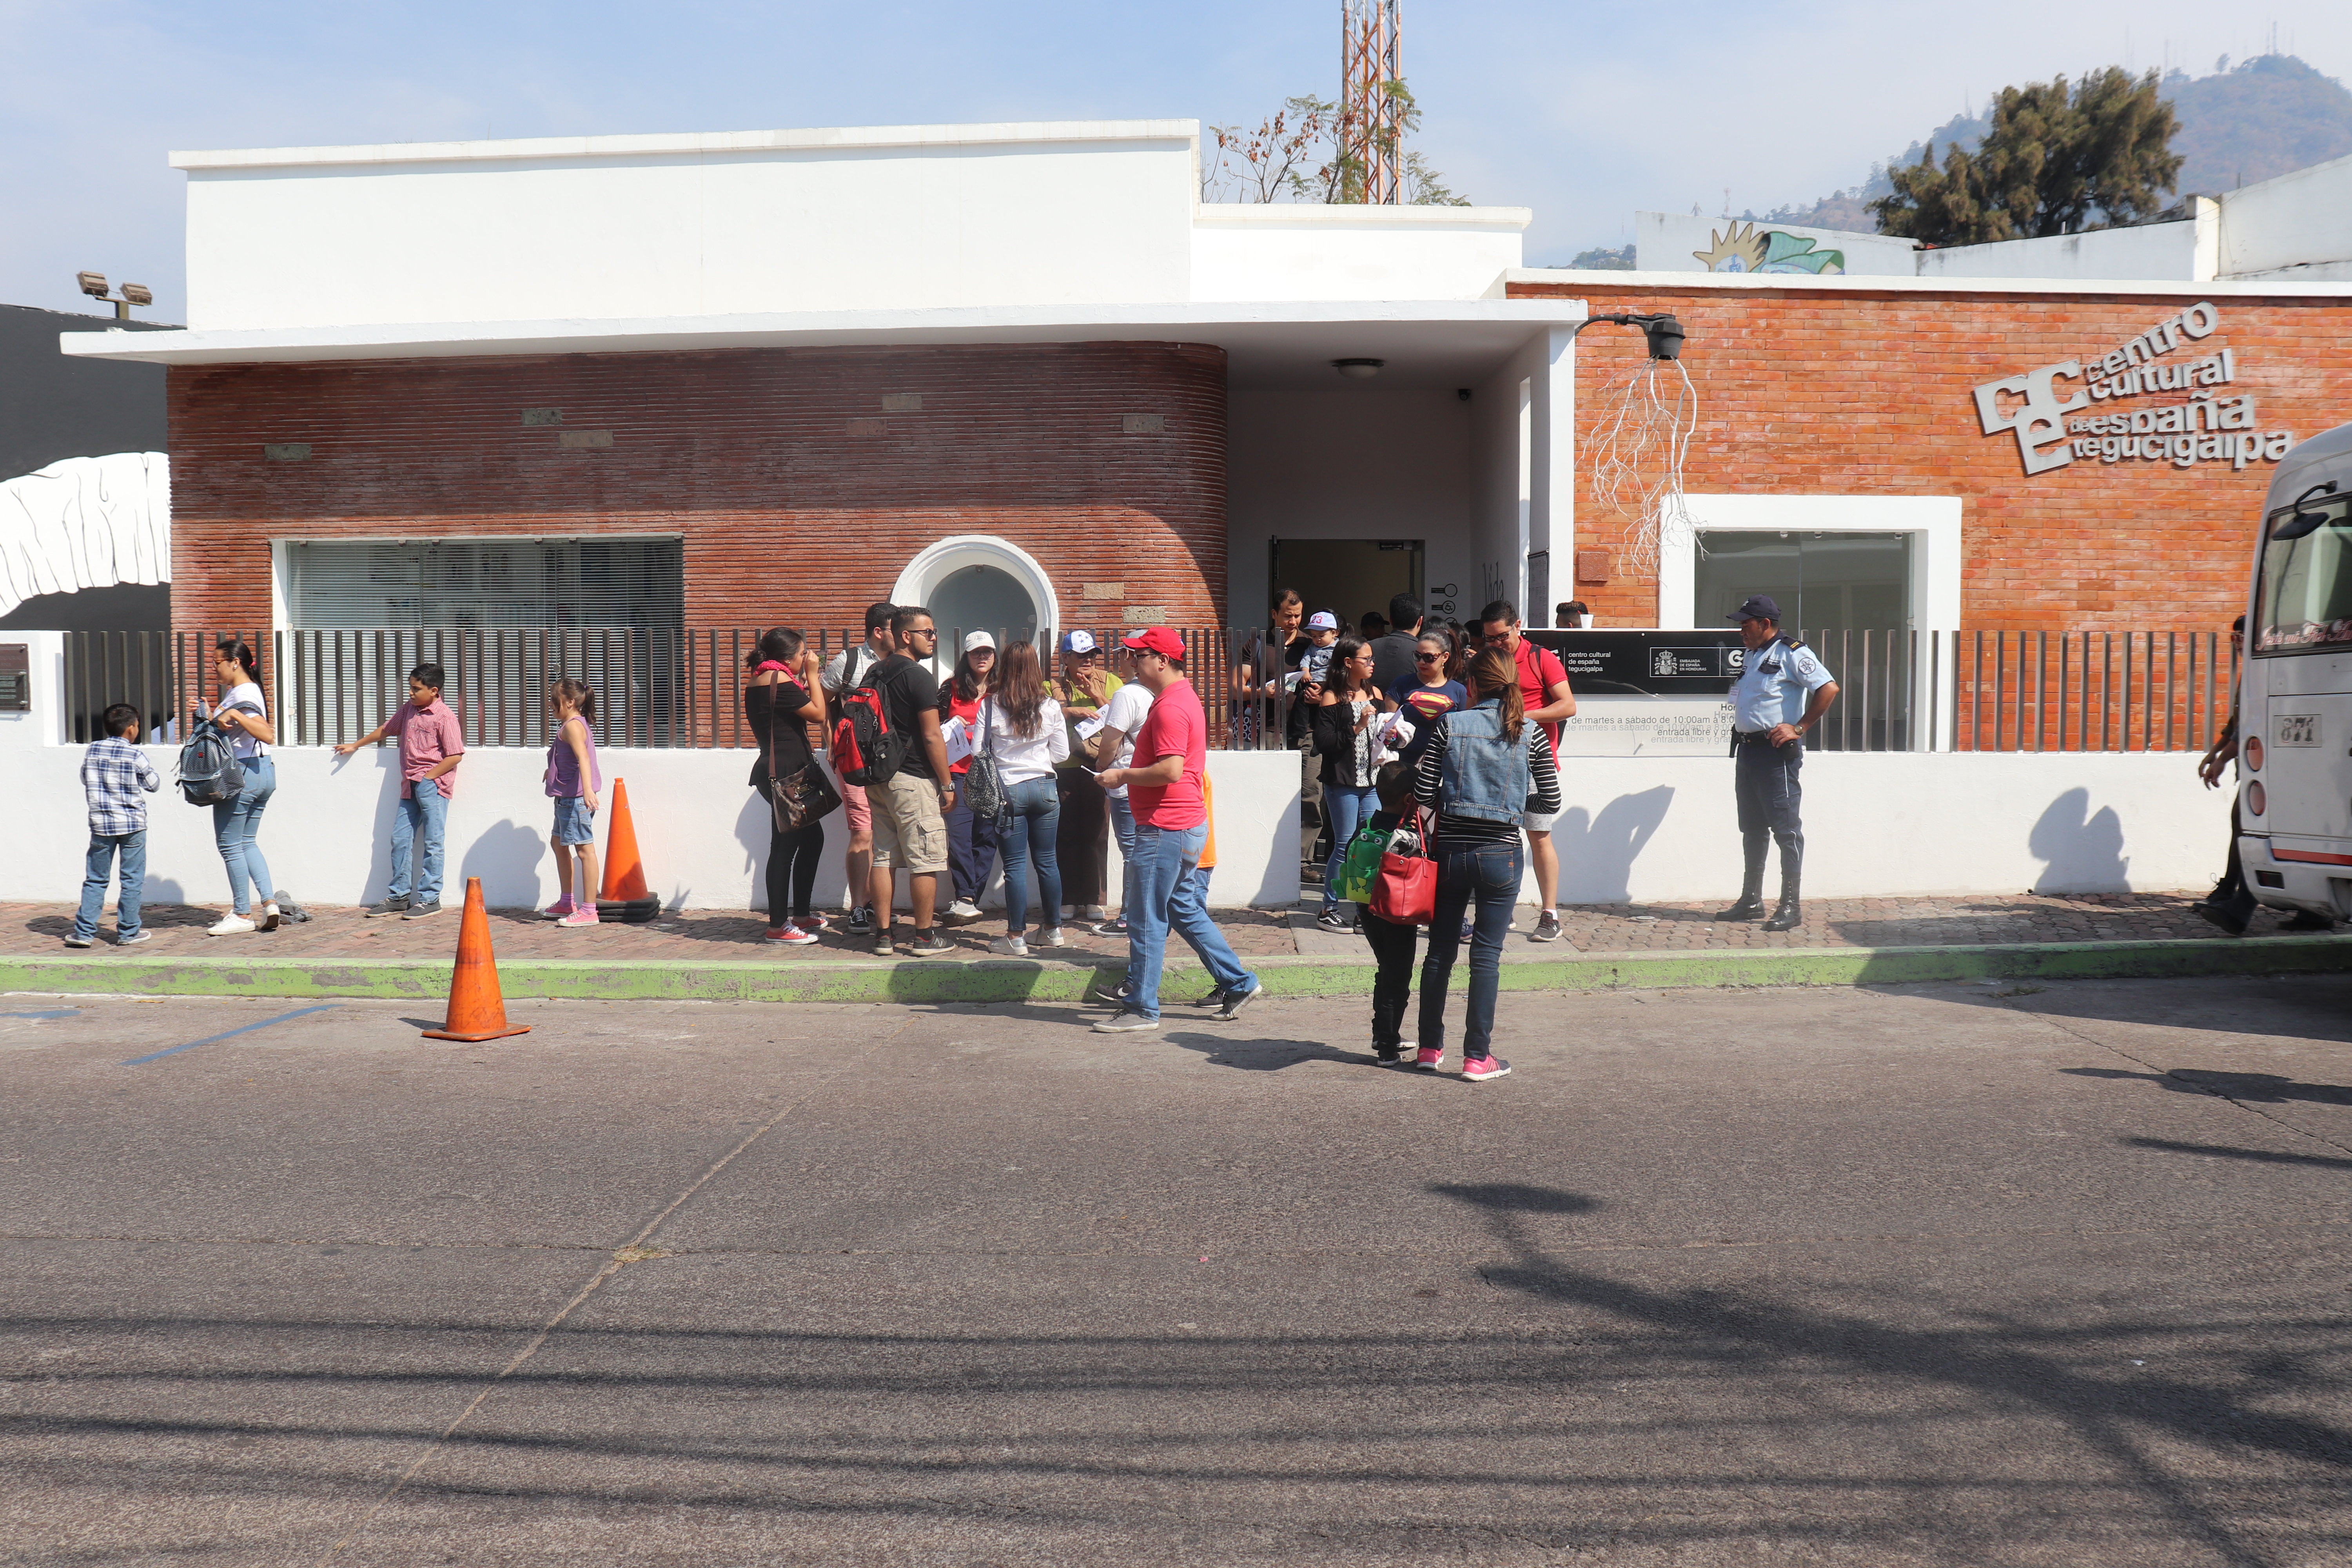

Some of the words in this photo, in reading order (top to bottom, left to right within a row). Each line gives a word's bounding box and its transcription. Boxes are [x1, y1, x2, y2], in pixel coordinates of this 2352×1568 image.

[2085, 301, 2219, 383] centro
[2091, 348, 2234, 399] cultural
[2070, 418, 2090, 432] de
[2089, 390, 2257, 435] españa
[1311, 615, 1323, 624] 23
